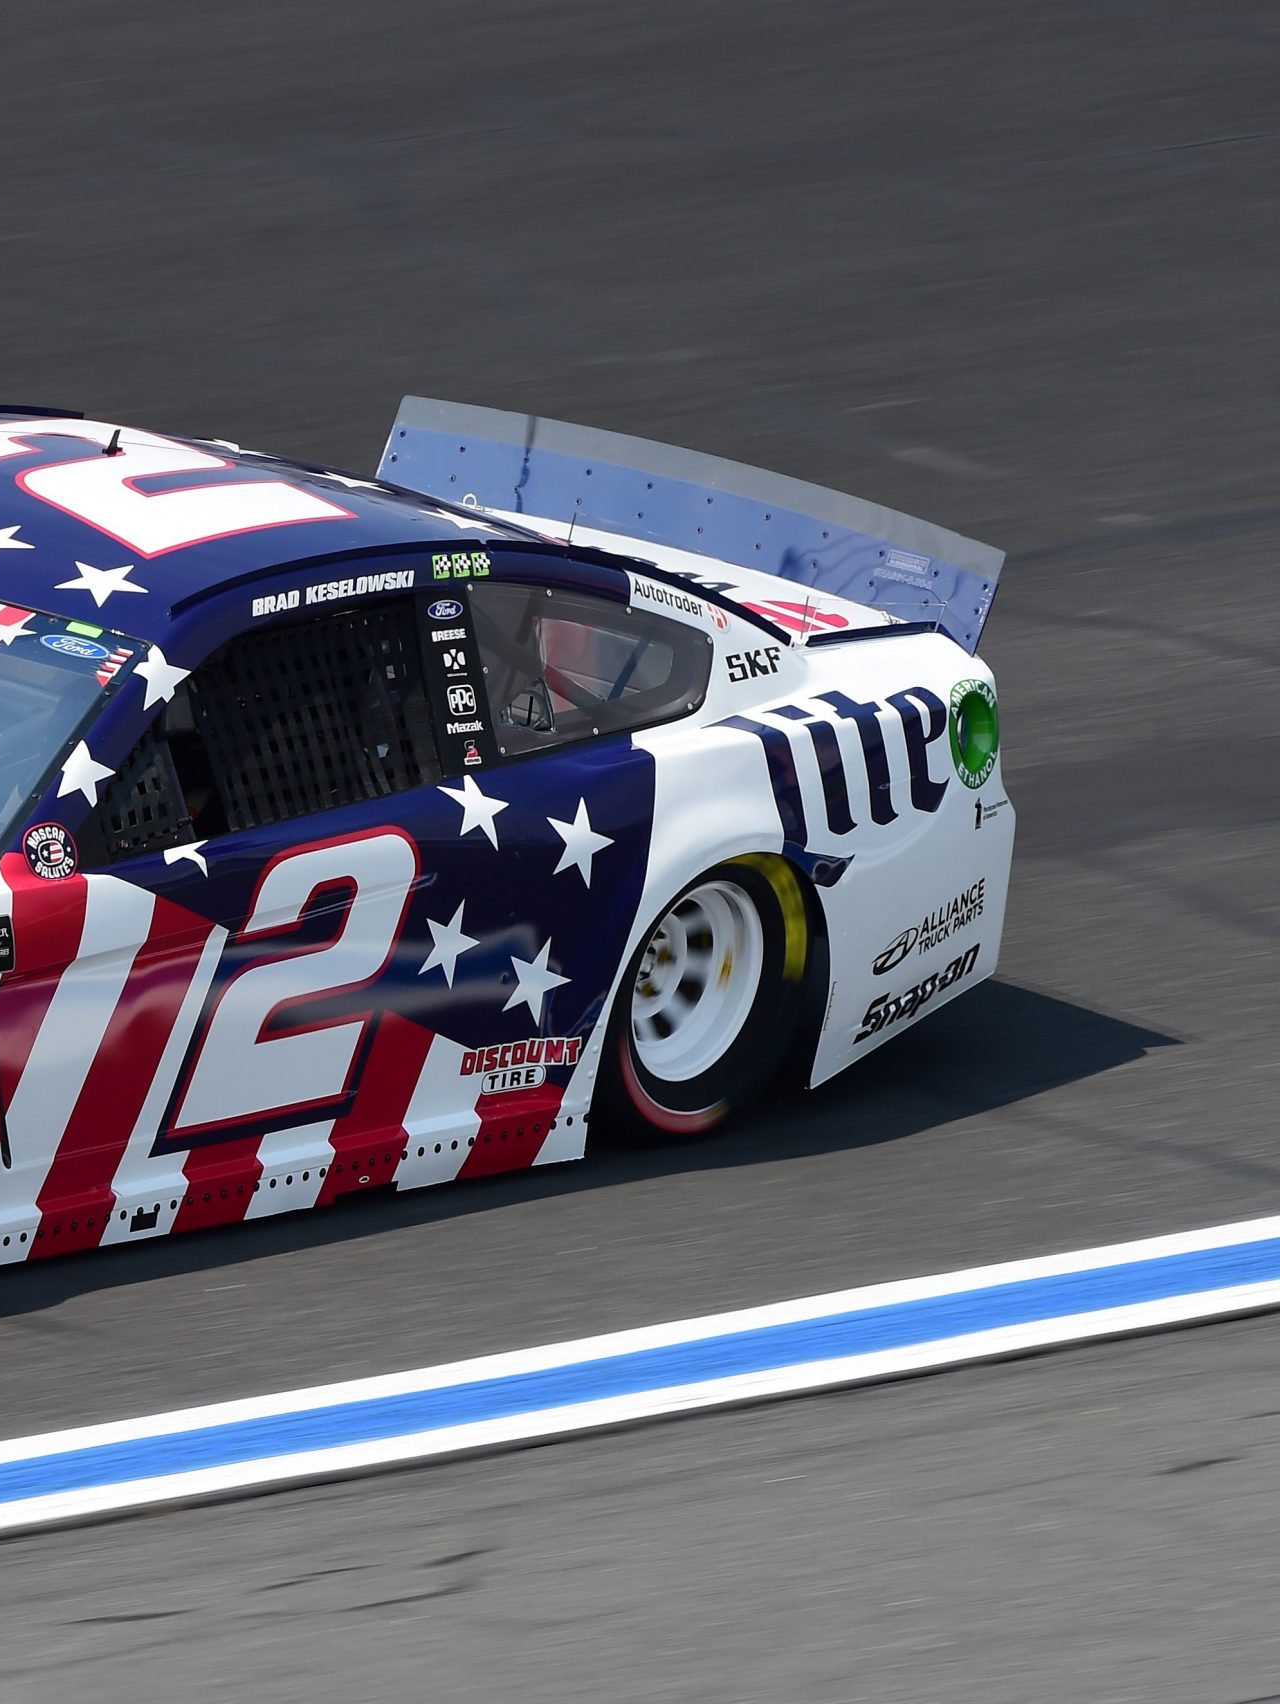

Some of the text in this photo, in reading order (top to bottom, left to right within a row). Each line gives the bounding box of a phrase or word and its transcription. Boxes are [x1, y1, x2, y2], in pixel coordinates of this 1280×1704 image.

[252, 570, 415, 617] BRAD KESELOWSKI
[435, 602, 457, 616] Ford
[634, 578, 704, 618] Autotrader
[52, 637, 97, 657] Ford
[437, 628, 467, 641] REESE
[725, 647, 781, 683] SKF
[450, 688, 474, 712] PPG
[951, 679, 996, 719] AMERICAN
[446, 720, 484, 735] Mazak
[957, 751, 997, 787] ETHANOL
[26, 826, 66, 850] NASCAR
[35, 856, 75, 879] SALUTES
[919, 877, 986, 939] ALLIANCE
[918, 899, 984, 955] TRUCK PARTS
[167, 828, 420, 1137] 2
[460, 1038, 582, 1076] DISCOUNT
[488, 1069, 536, 1090] TIRE
